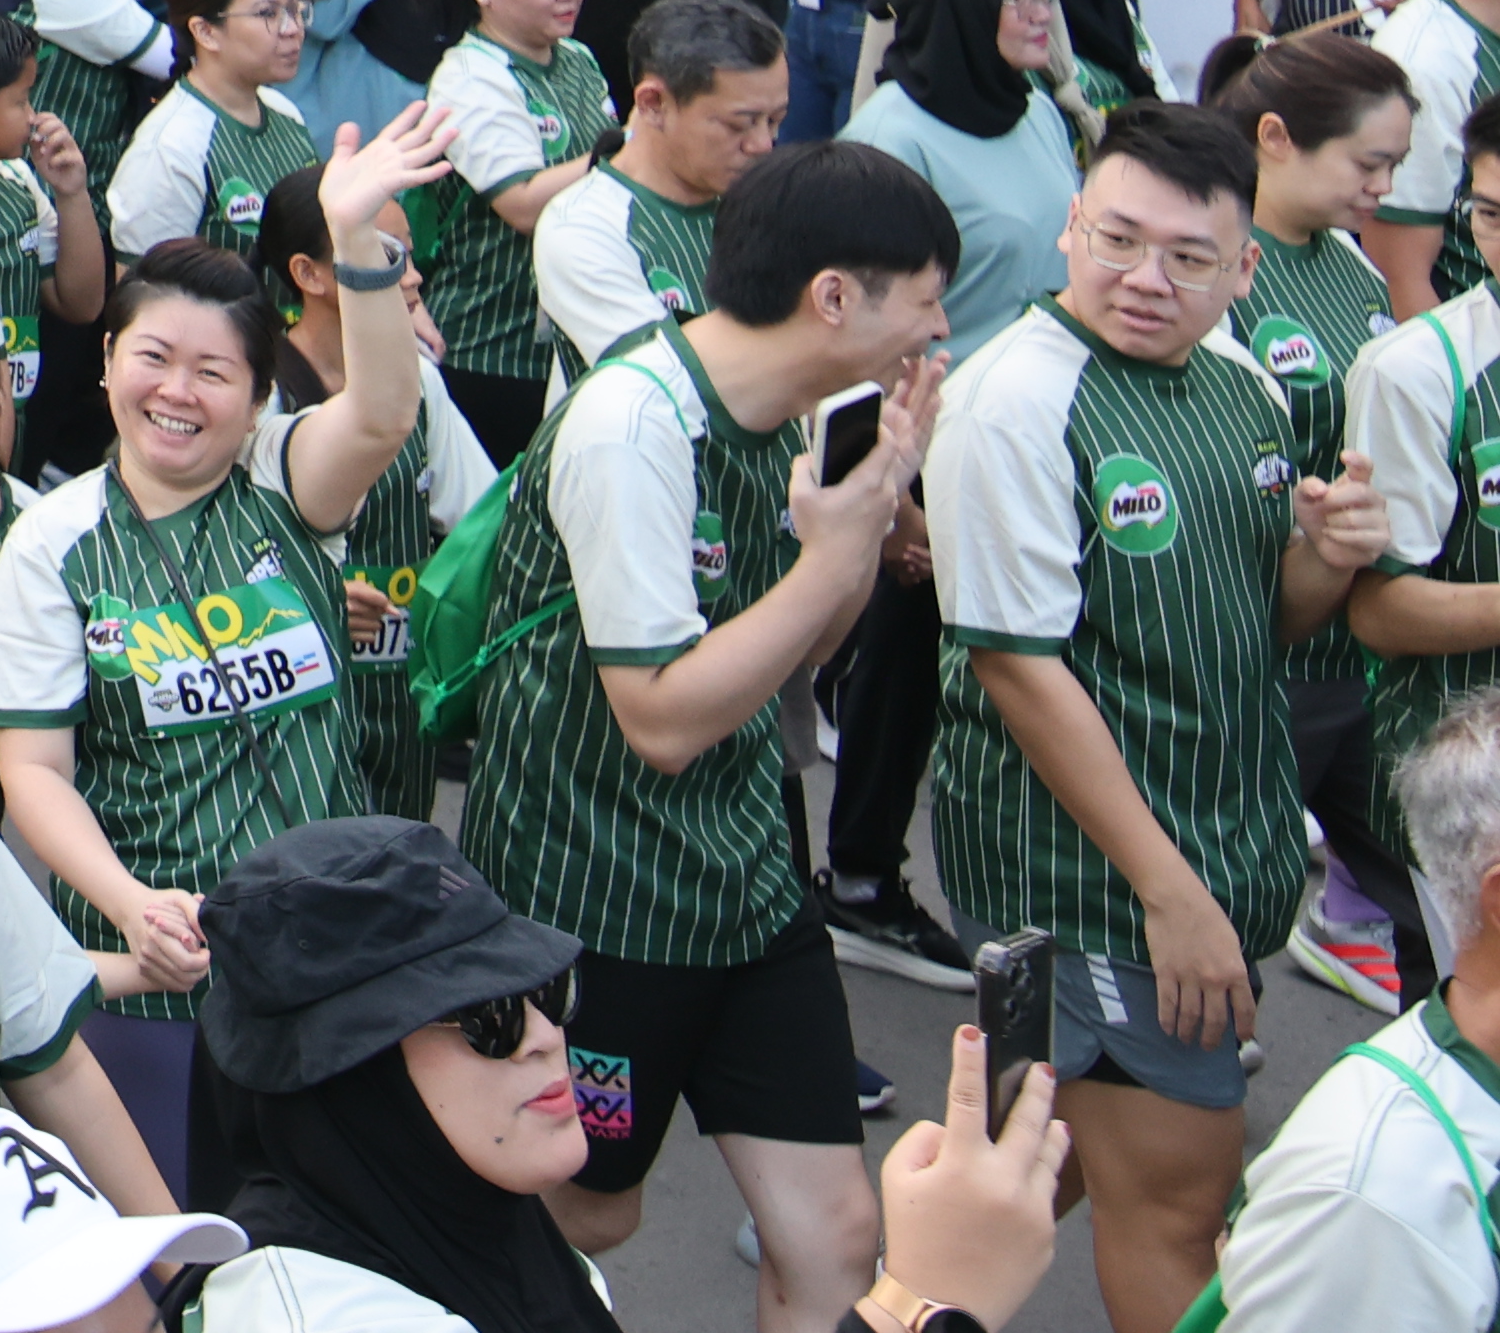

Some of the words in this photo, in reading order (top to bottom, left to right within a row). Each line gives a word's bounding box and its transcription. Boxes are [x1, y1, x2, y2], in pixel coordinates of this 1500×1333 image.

[1270, 346, 1312, 365] MILO
[1108, 491, 1162, 523] MILO
[123, 594, 244, 684] MILO
